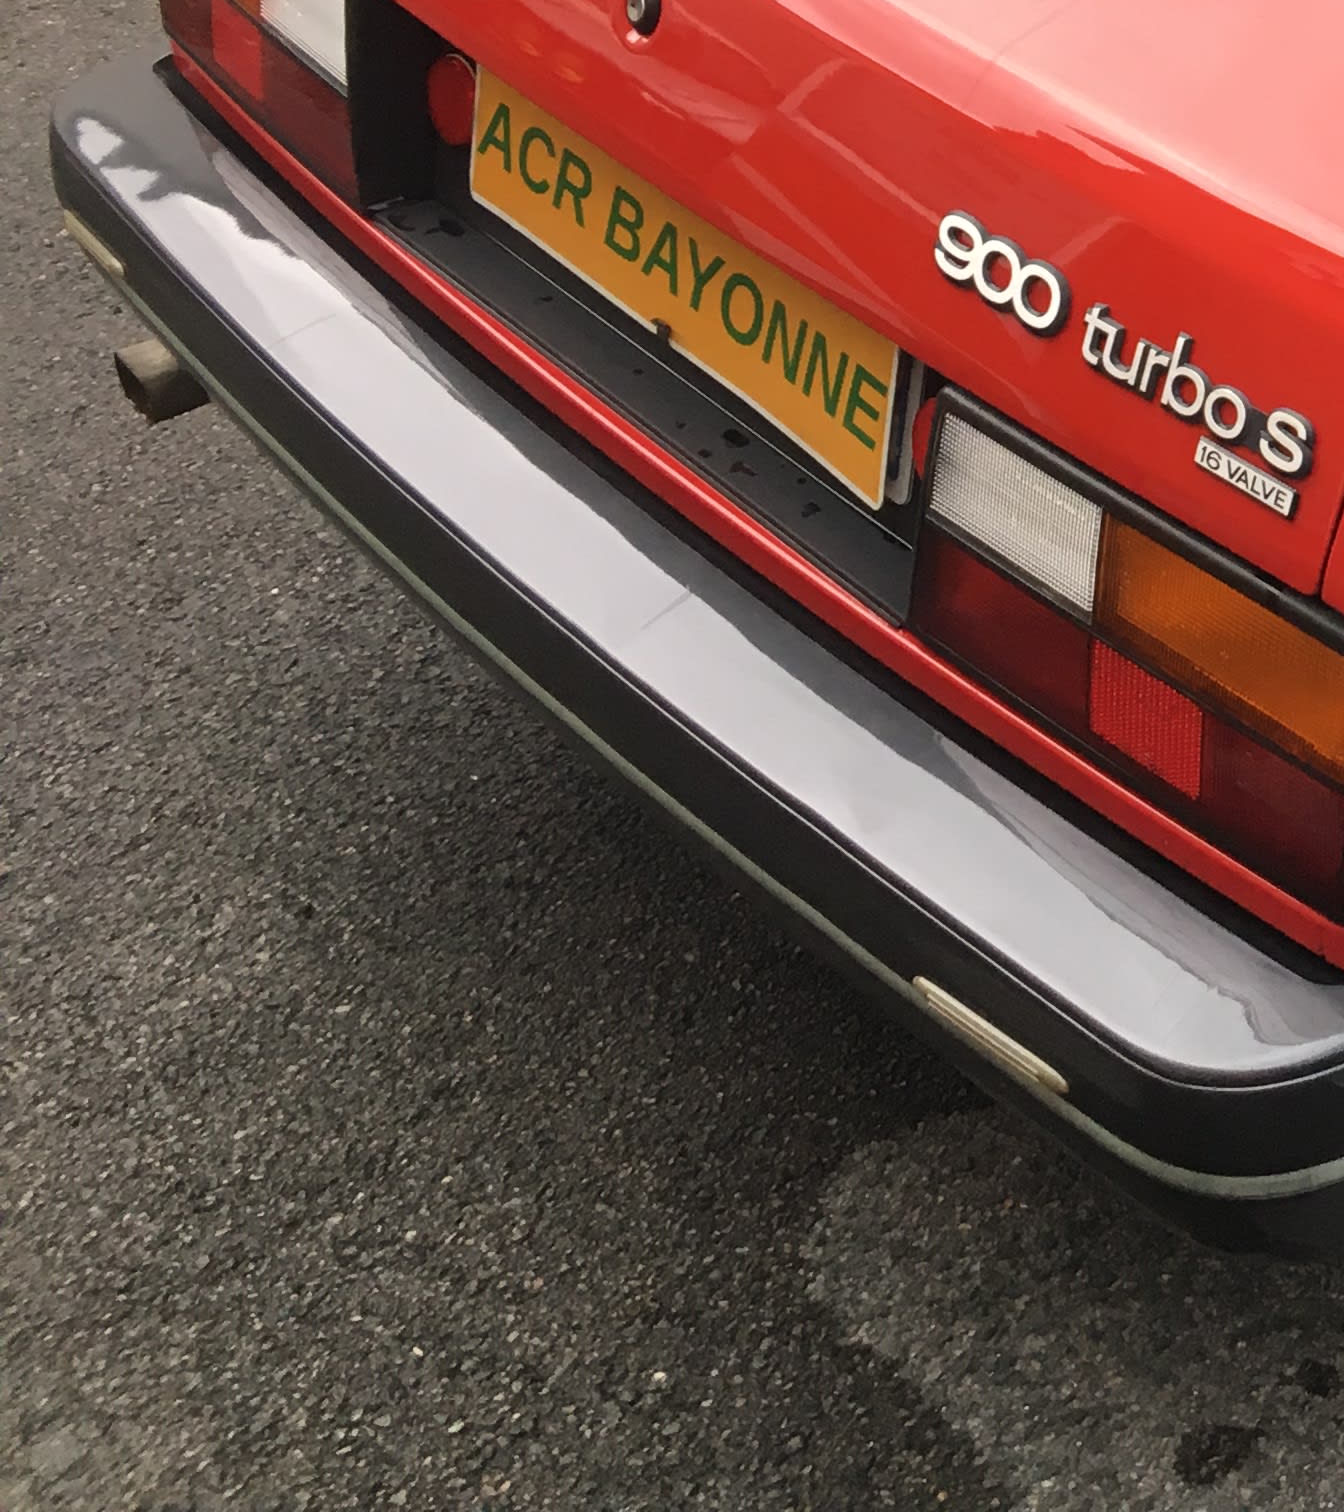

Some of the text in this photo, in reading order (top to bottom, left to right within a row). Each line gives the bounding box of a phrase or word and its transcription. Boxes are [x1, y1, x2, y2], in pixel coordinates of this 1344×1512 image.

[476, 102, 888, 452] ACR BAYONNE
[934, 211, 1310, 474] 900 turbo S
[1200, 445, 1288, 510] 16 VALVE
